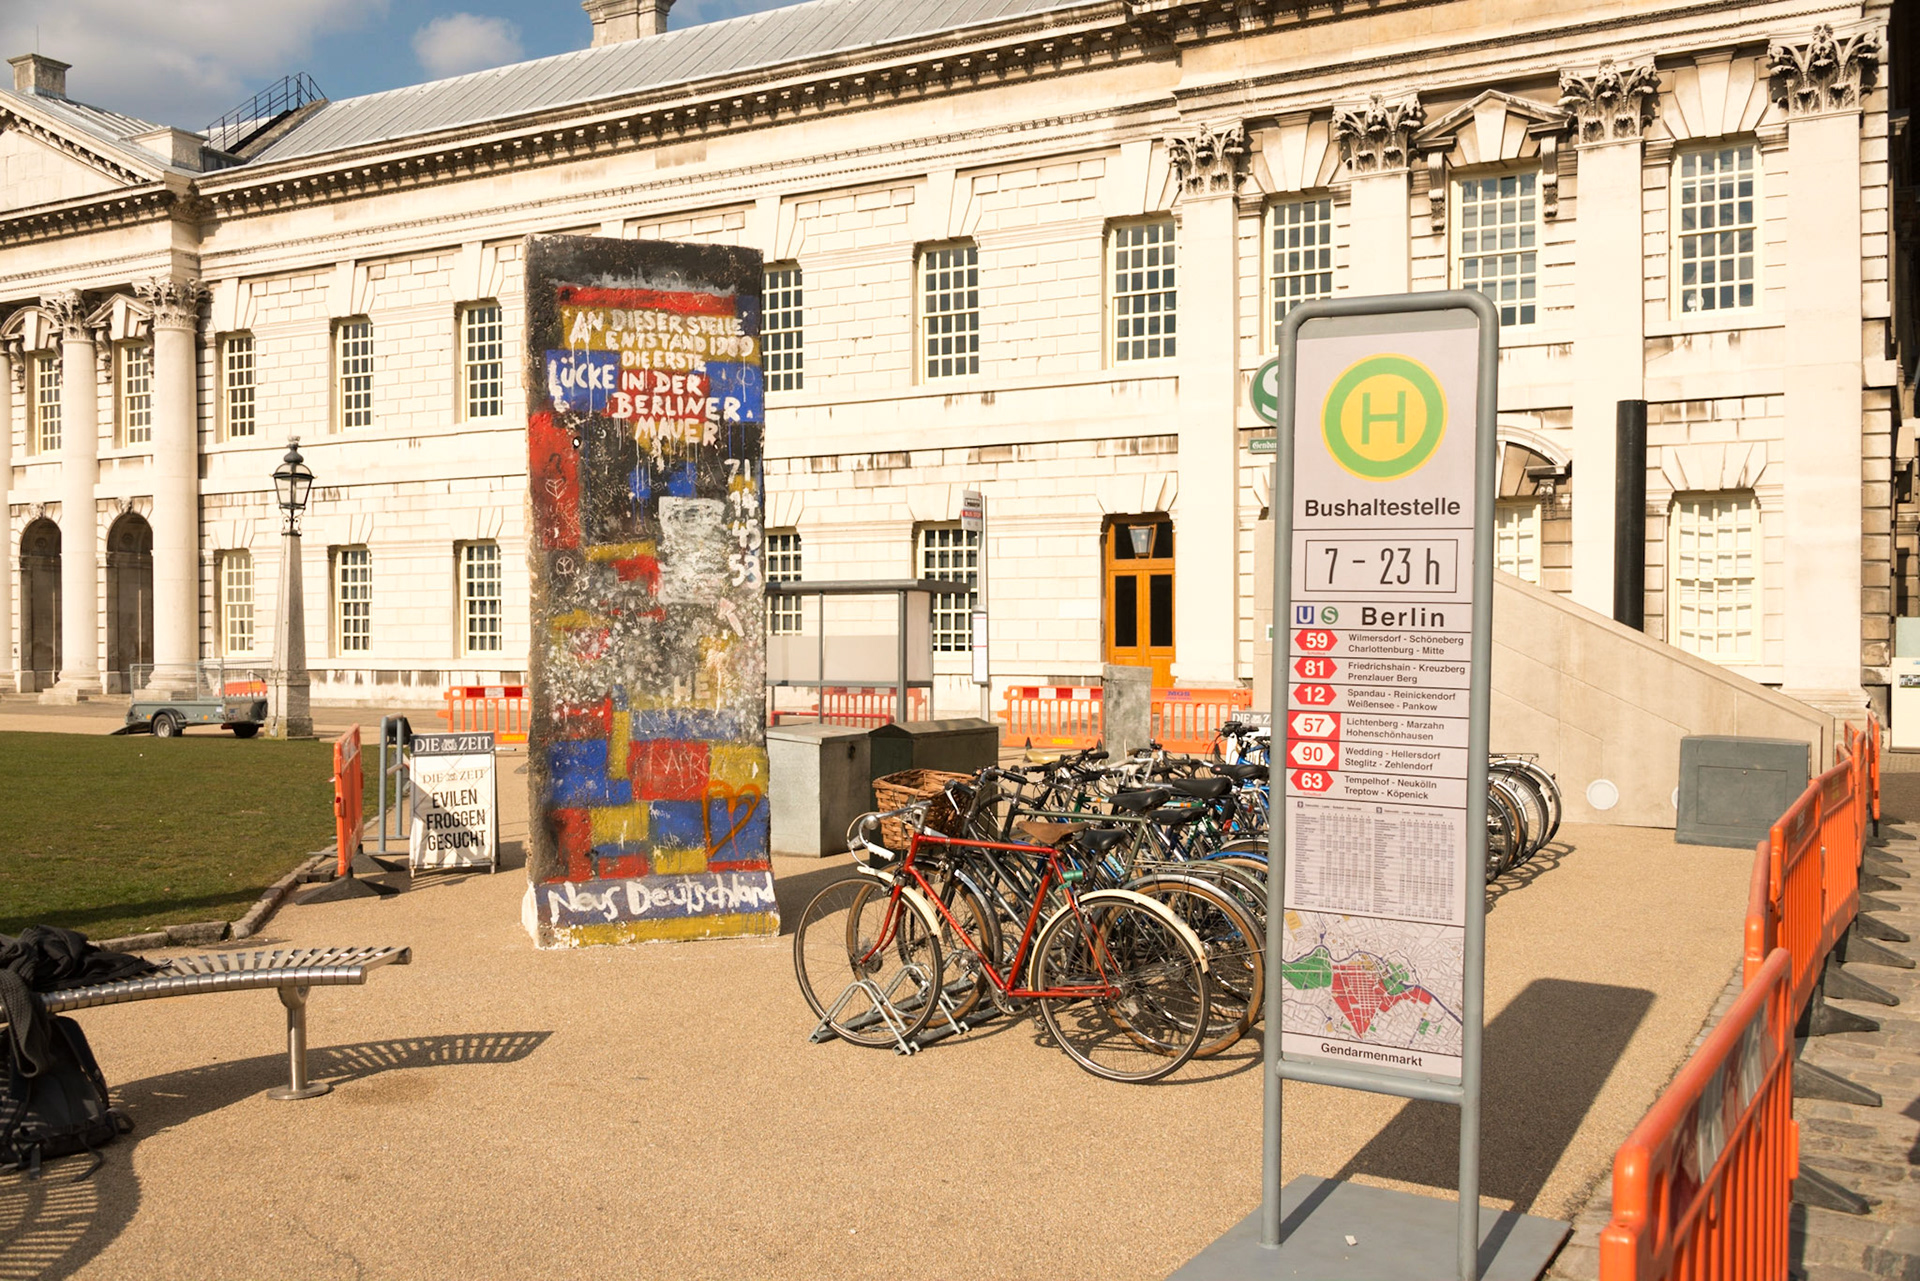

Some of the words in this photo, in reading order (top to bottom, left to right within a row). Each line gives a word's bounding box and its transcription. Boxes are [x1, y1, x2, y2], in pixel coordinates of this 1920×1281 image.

[568, 311, 604, 343] AN
[611, 309, 685, 335] DIESER
[687, 316, 746, 337] STELLE
[605, 331, 707, 352] ENTSTAND
[710, 336, 755, 357] 1989
[622, 351, 650, 369] DIE
[652, 352, 708, 373] ERSTE
[621, 371, 645, 391] IN
[653, 371, 703, 396] DER
[1361, 391, 1406, 445] H
[635, 417, 719, 446] MAUER
[1305, 498, 1461, 517] Bushaltestelle
[1325, 548, 1338, 584] 7
[1380, 548, 1411, 585] 23
[1425, 548, 1440, 585] h
[1298, 606, 1313, 623] U
[1323, 608, 1337, 624] S
[1361, 606, 1445, 627] Berlin
[1305, 632, 1328, 648] 59
[1348, 634, 1401, 643] Wilmersdorf
[1409, 635, 1464, 645] Schöneberg
[1348, 645, 1414, 655] Charlottenburg
[1422, 646, 1444, 655] Mitte
[1304, 660, 1325, 676] 81
[1348, 662, 1411, 671] Friedrichshain
[1418, 664, 1466, 675] Kreuzberg
[1348, 672, 1394, 682] Prenzlauer
[1396, 674, 1418, 684] Berg
[1304, 686, 1325, 702] 12
[1347, 689, 1386, 698] Spandau
[1393, 691, 1456, 701] Reinickendorf
[1347, 699, 1395, 709] Weißensee
[1402, 702, 1438, 711] Pankow
[1232, 713, 1251, 723] DIE
[1303, 718, 1325, 733] 57
[1346, 718, 1399, 730] Lichtenberg
[1406, 720, 1445, 730] Marzahn
[1346, 729, 1434, 741] Hohenschönhausen
[414, 738, 440, 752] DIE
[458, 736, 492, 751] ZEIT
[1302, 746, 1323, 762] 90
[1345, 747, 1383, 758] Wedding
[1391, 750, 1440, 760] Hellersdorf
[1344, 758, 1377, 768] Steglitz
[1384, 760, 1433, 771] Zehlendorf
[422, 773, 443, 784] DIE
[459, 769, 486, 781] ZEIT
[1301, 773, 1323, 789] 63
[1344, 776, 1390, 788] Tempelhof
[1397, 779, 1437, 789] Neukölln
[431, 789, 478, 809] EVILEN
[1344, 786, 1379, 797] Treptow
[1386, 789, 1429, 800] Köpenick
[426, 809, 486, 831] FROGGEN
[427, 830, 487, 851] GESUCHT
[1321, 1043, 1423, 1067] Gendarmenmarkt
